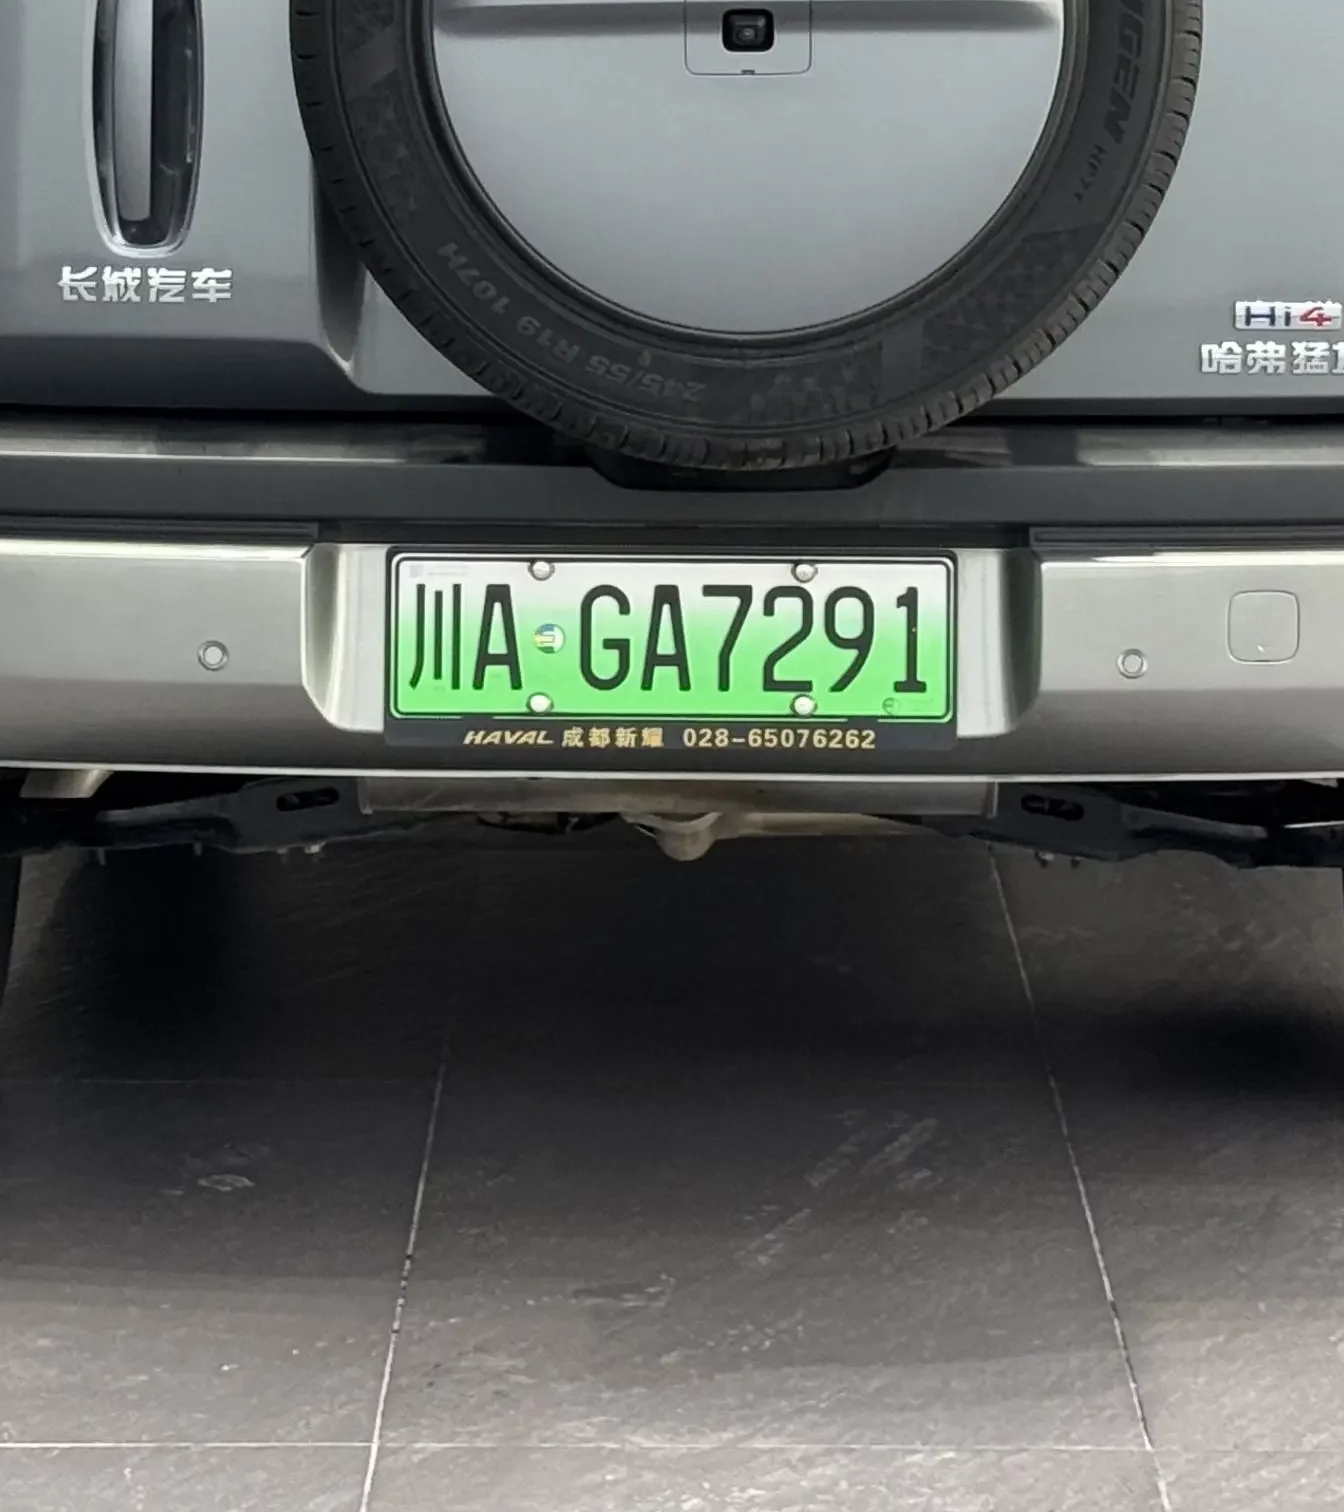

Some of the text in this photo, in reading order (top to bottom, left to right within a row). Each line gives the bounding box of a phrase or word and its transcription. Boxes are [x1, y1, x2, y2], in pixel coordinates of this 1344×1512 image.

[57, 265, 233, 304] 长城汽车
[1243, 304, 1334, 328] Hi4
[462, 728, 554, 746] HAVAL
[683, 728, 877, 750] 028-65076262
